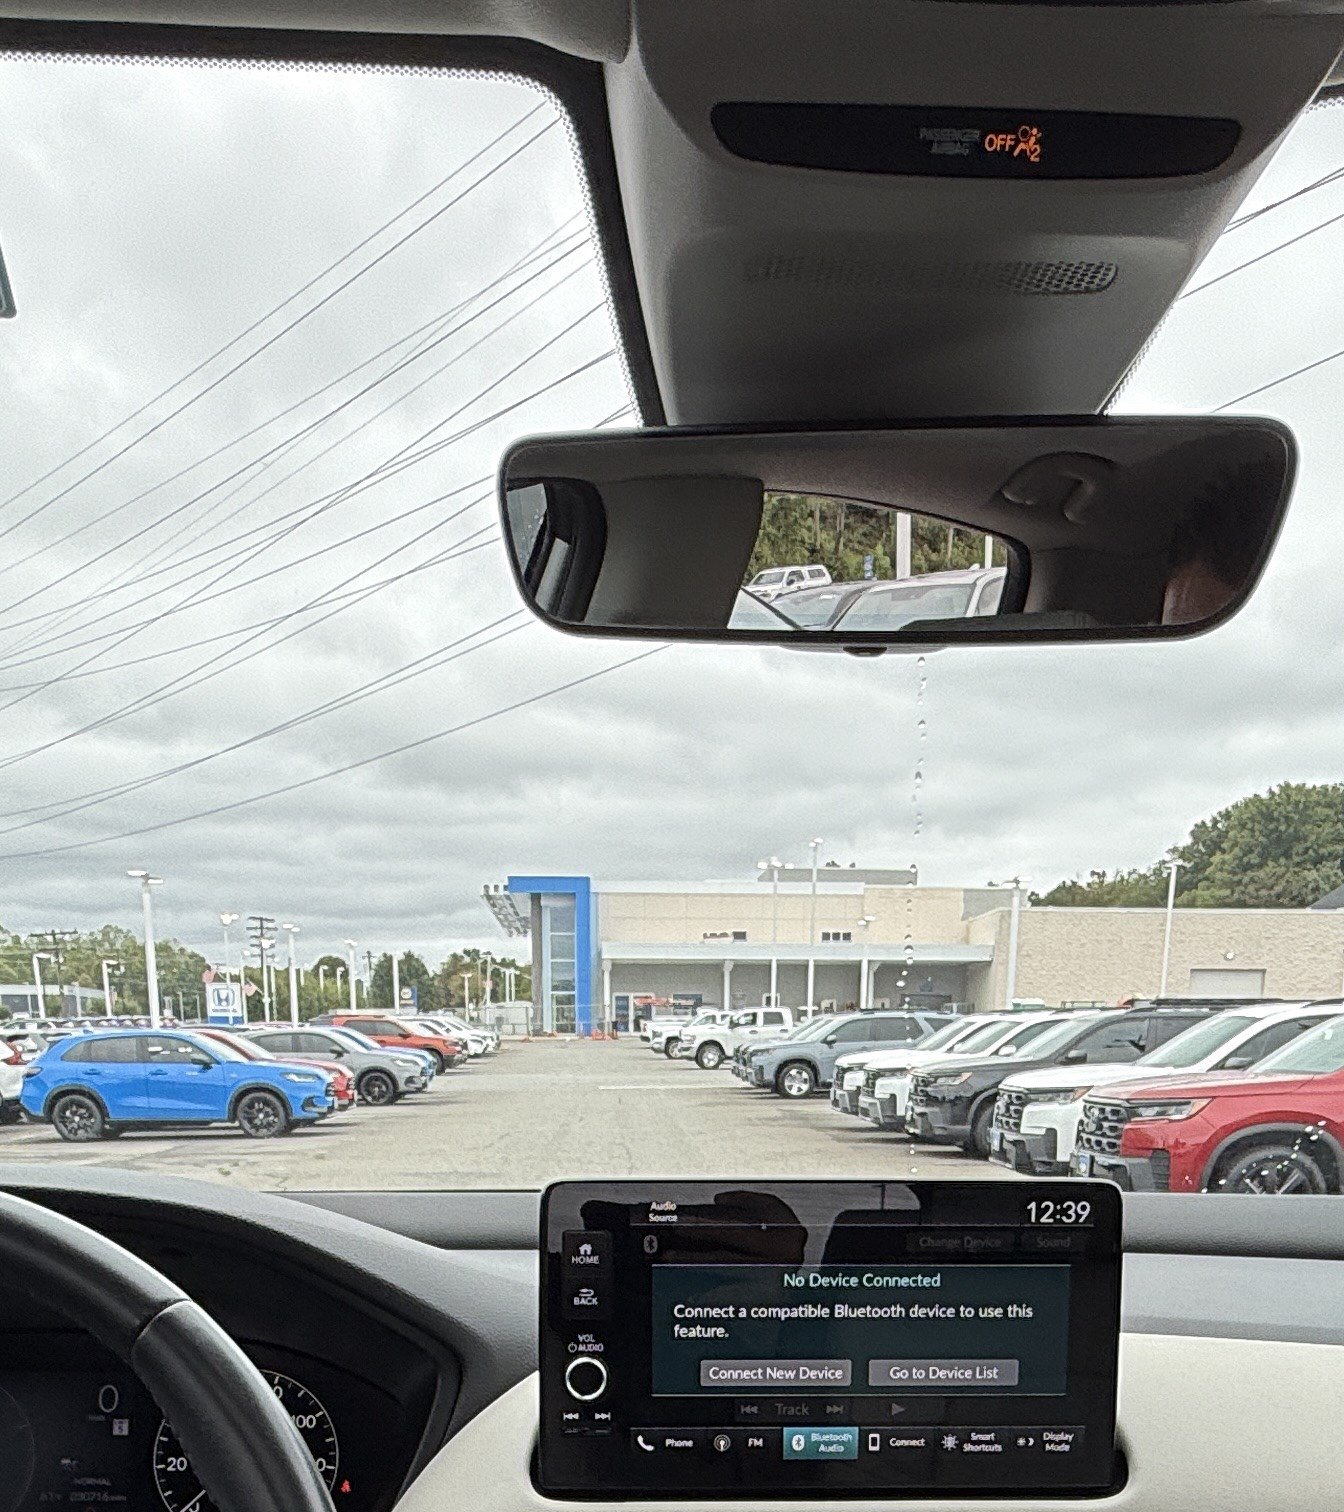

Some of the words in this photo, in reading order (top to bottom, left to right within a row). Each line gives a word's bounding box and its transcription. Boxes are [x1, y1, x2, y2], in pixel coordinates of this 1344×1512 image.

[985, 133, 1017, 152] OFF
[650, 1201, 677, 1211] Audio
[648, 1213, 678, 1222] Source
[1026, 1201, 1091, 1224] 12:39
[1037, 1236, 1071, 1247] Sound
[572, 1255, 600, 1265] HOME
[783, 1273, 804, 1287] No
[809, 1273, 859, 1287] Device
[863, 1273, 941, 1287] Connected
[573, 1296, 598, 1305] BACK
[673, 1304, 734, 1318] Connect
[740, 1308, 747, 1318] a
[751, 1304, 830, 1321] compatible
[834, 1304, 905, 1318] Bluetooth
[909, 1304, 956, 1318] device
[960, 1306, 974, 1318] to
[979, 1308, 1003, 1318] use
[1007, 1304, 1033, 1318] this
[673, 1324, 729, 1338] feature.
[577, 1333, 596, 1342] VOL
[578, 1343, 604, 1352] AUDIO
[709, 1366, 763, 1379] Connect
[767, 1366, 795, 1379] New
[799, 1366, 843, 1379] Device
[889, 1366, 909, 1379] Go
[912, 1367, 925, 1379] to
[929, 1366, 972, 1379] Device
[976, 1366, 999, 1379] List
[98, 1384, 119, 1413] 0
[775, 1404, 809, 1415] Track
[811, 1432, 853, 1442] Bluetooth
[971, 1432, 995, 1441] Smart
[1043, 1432, 1074, 1443] Display
[665, 1438, 694, 1448] Phone
[748, 1438, 764, 1448] FM
[889, 1437, 926, 1447] Connect
[818, 1444, 845, 1453] Audio
[963, 1443, 1003, 1452] Shortcuts
[1045, 1443, 1071, 1452] Mode
[167, 1457, 187, 1471] 20
